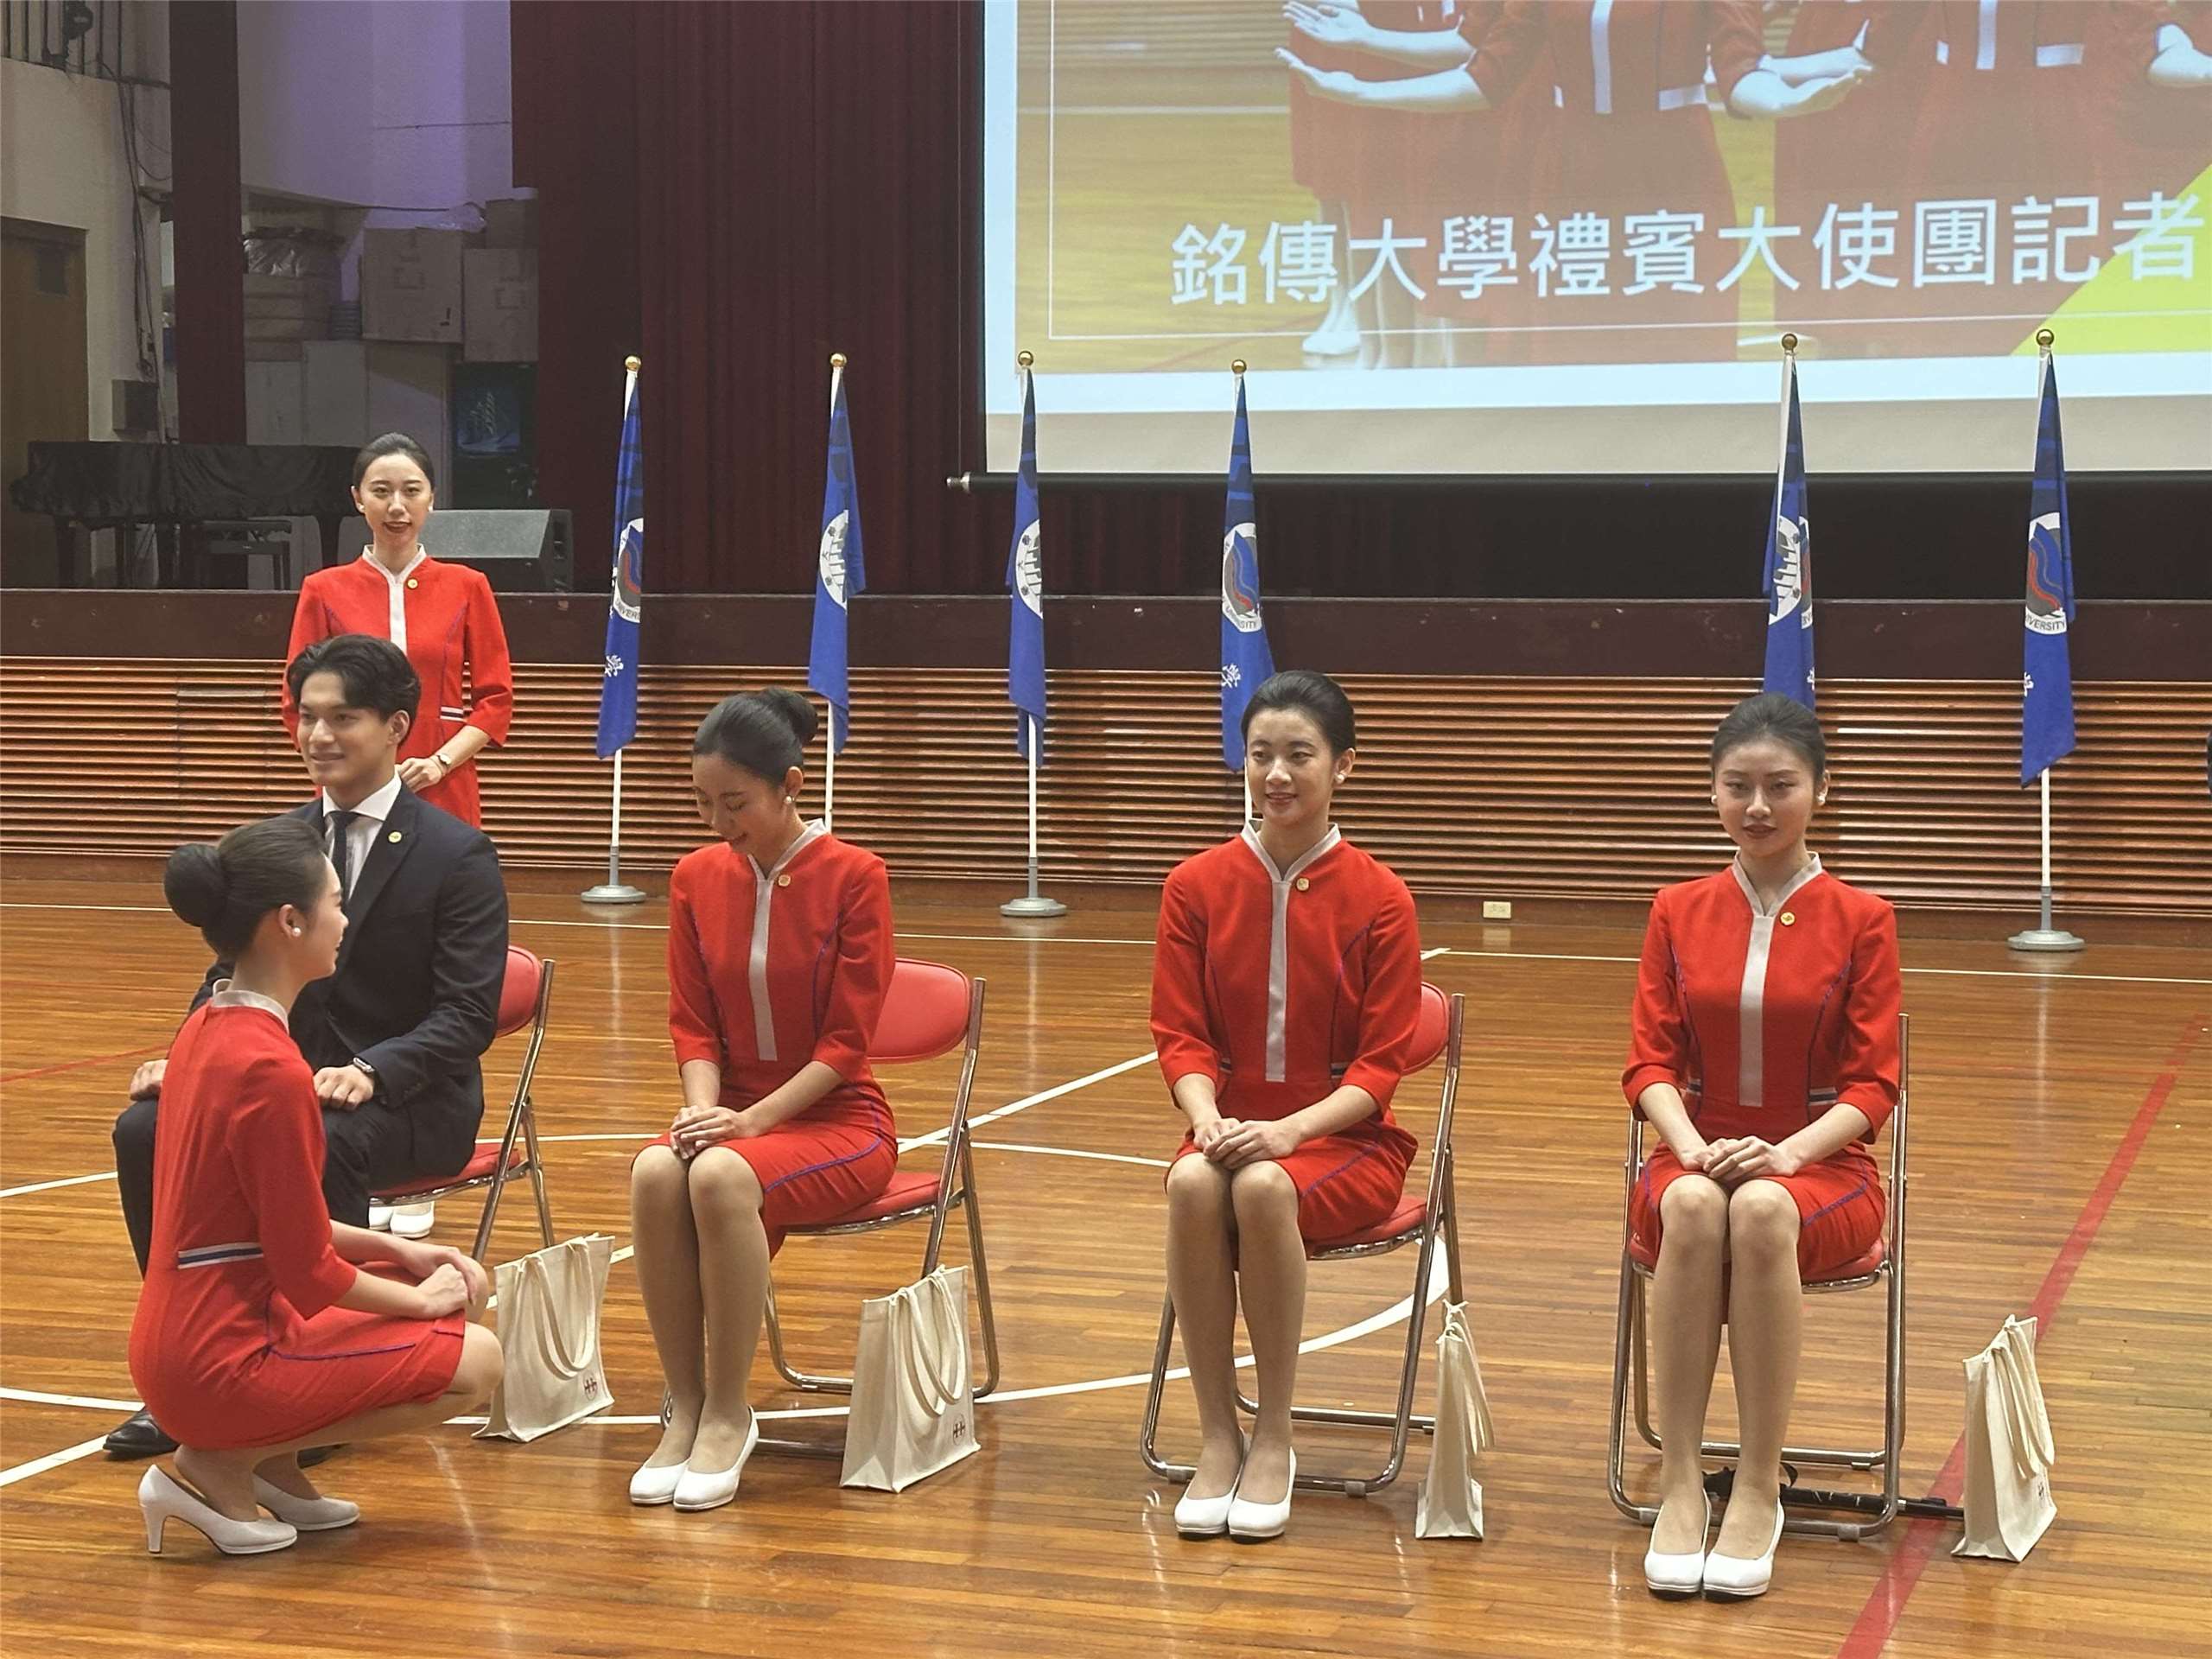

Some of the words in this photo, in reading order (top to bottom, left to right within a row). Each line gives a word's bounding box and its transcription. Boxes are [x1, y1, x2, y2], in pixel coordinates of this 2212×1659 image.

[1171, 192, 2201, 305] 銘傳大學禮賓大使團記者
